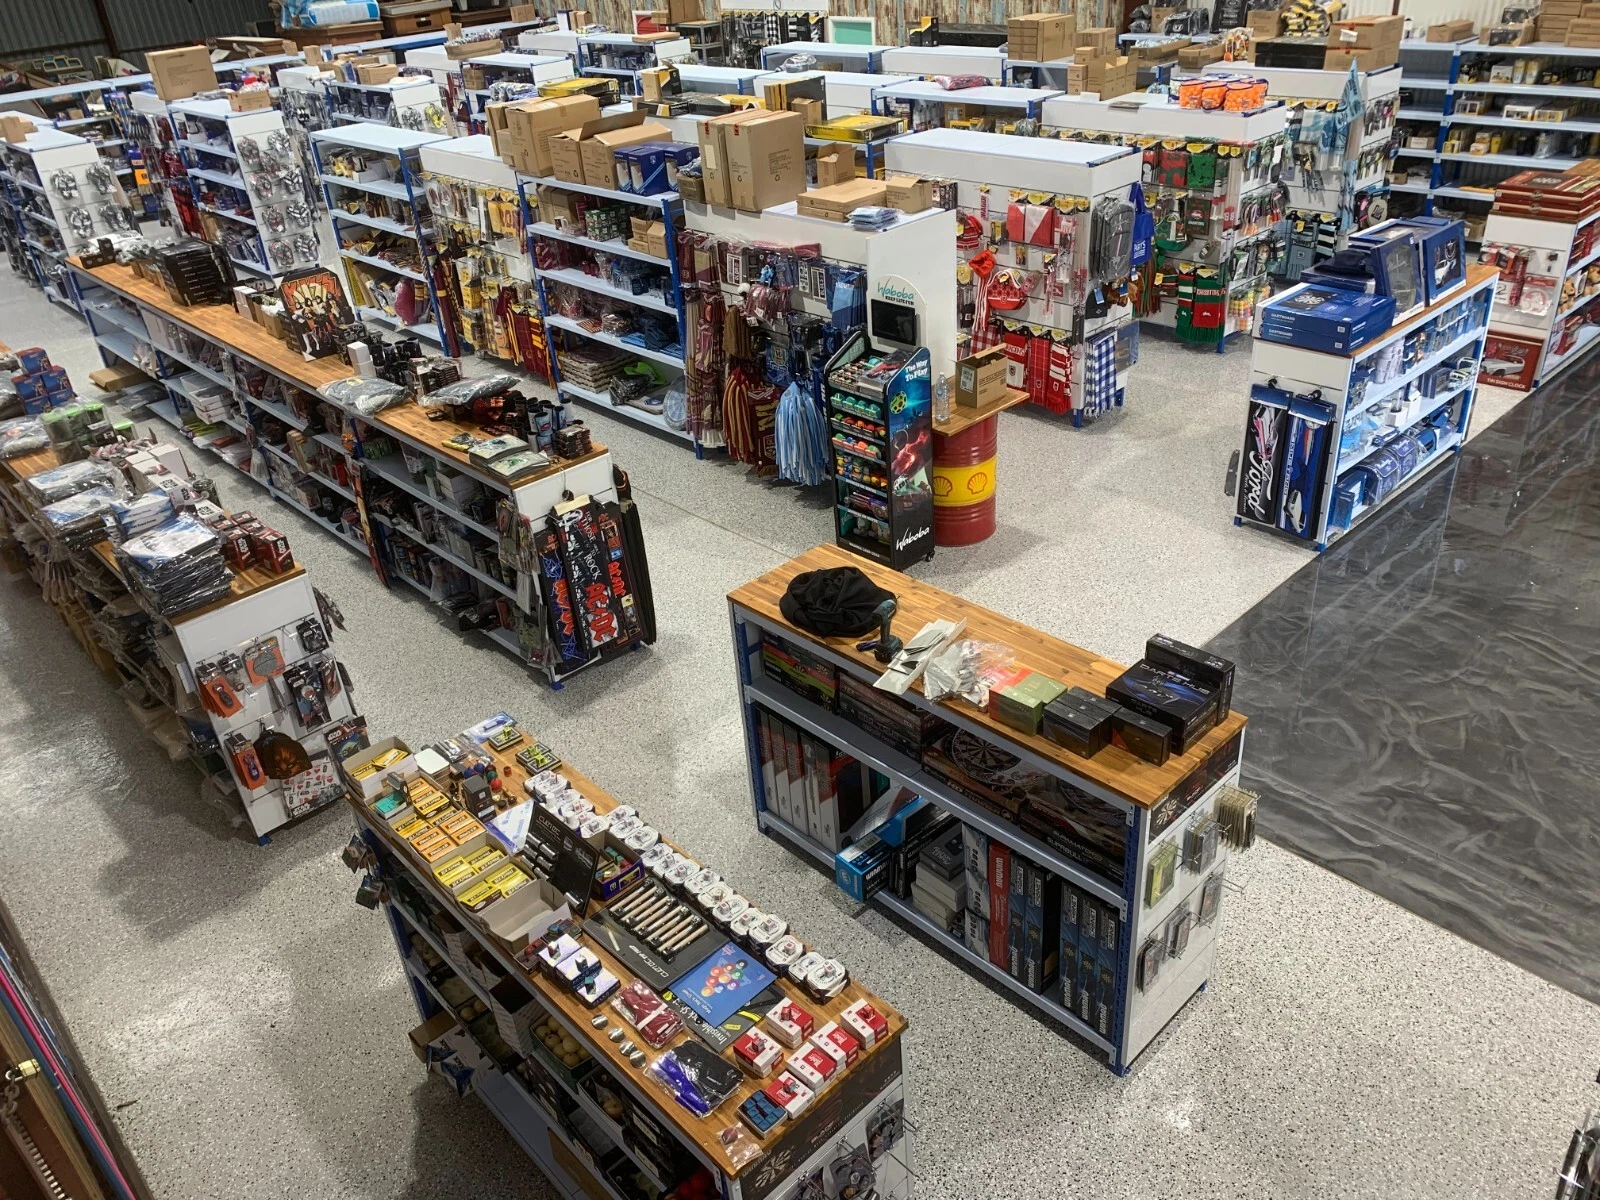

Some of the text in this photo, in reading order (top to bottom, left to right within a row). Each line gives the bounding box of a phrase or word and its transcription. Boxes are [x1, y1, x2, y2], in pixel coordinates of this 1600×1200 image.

[877, 276, 915, 300] Waboba
[905, 364, 916, 374] The
[905, 368, 928, 382] To Play
[1249, 450, 1272, 515] Ford
[581, 518, 597, 543] THOSE
[895, 526, 931, 551] Waboba
[583, 552, 602, 580] ROCK
[1140, 663, 1181, 683] DARTS
[702, 1022, 728, 1045] Invisible
